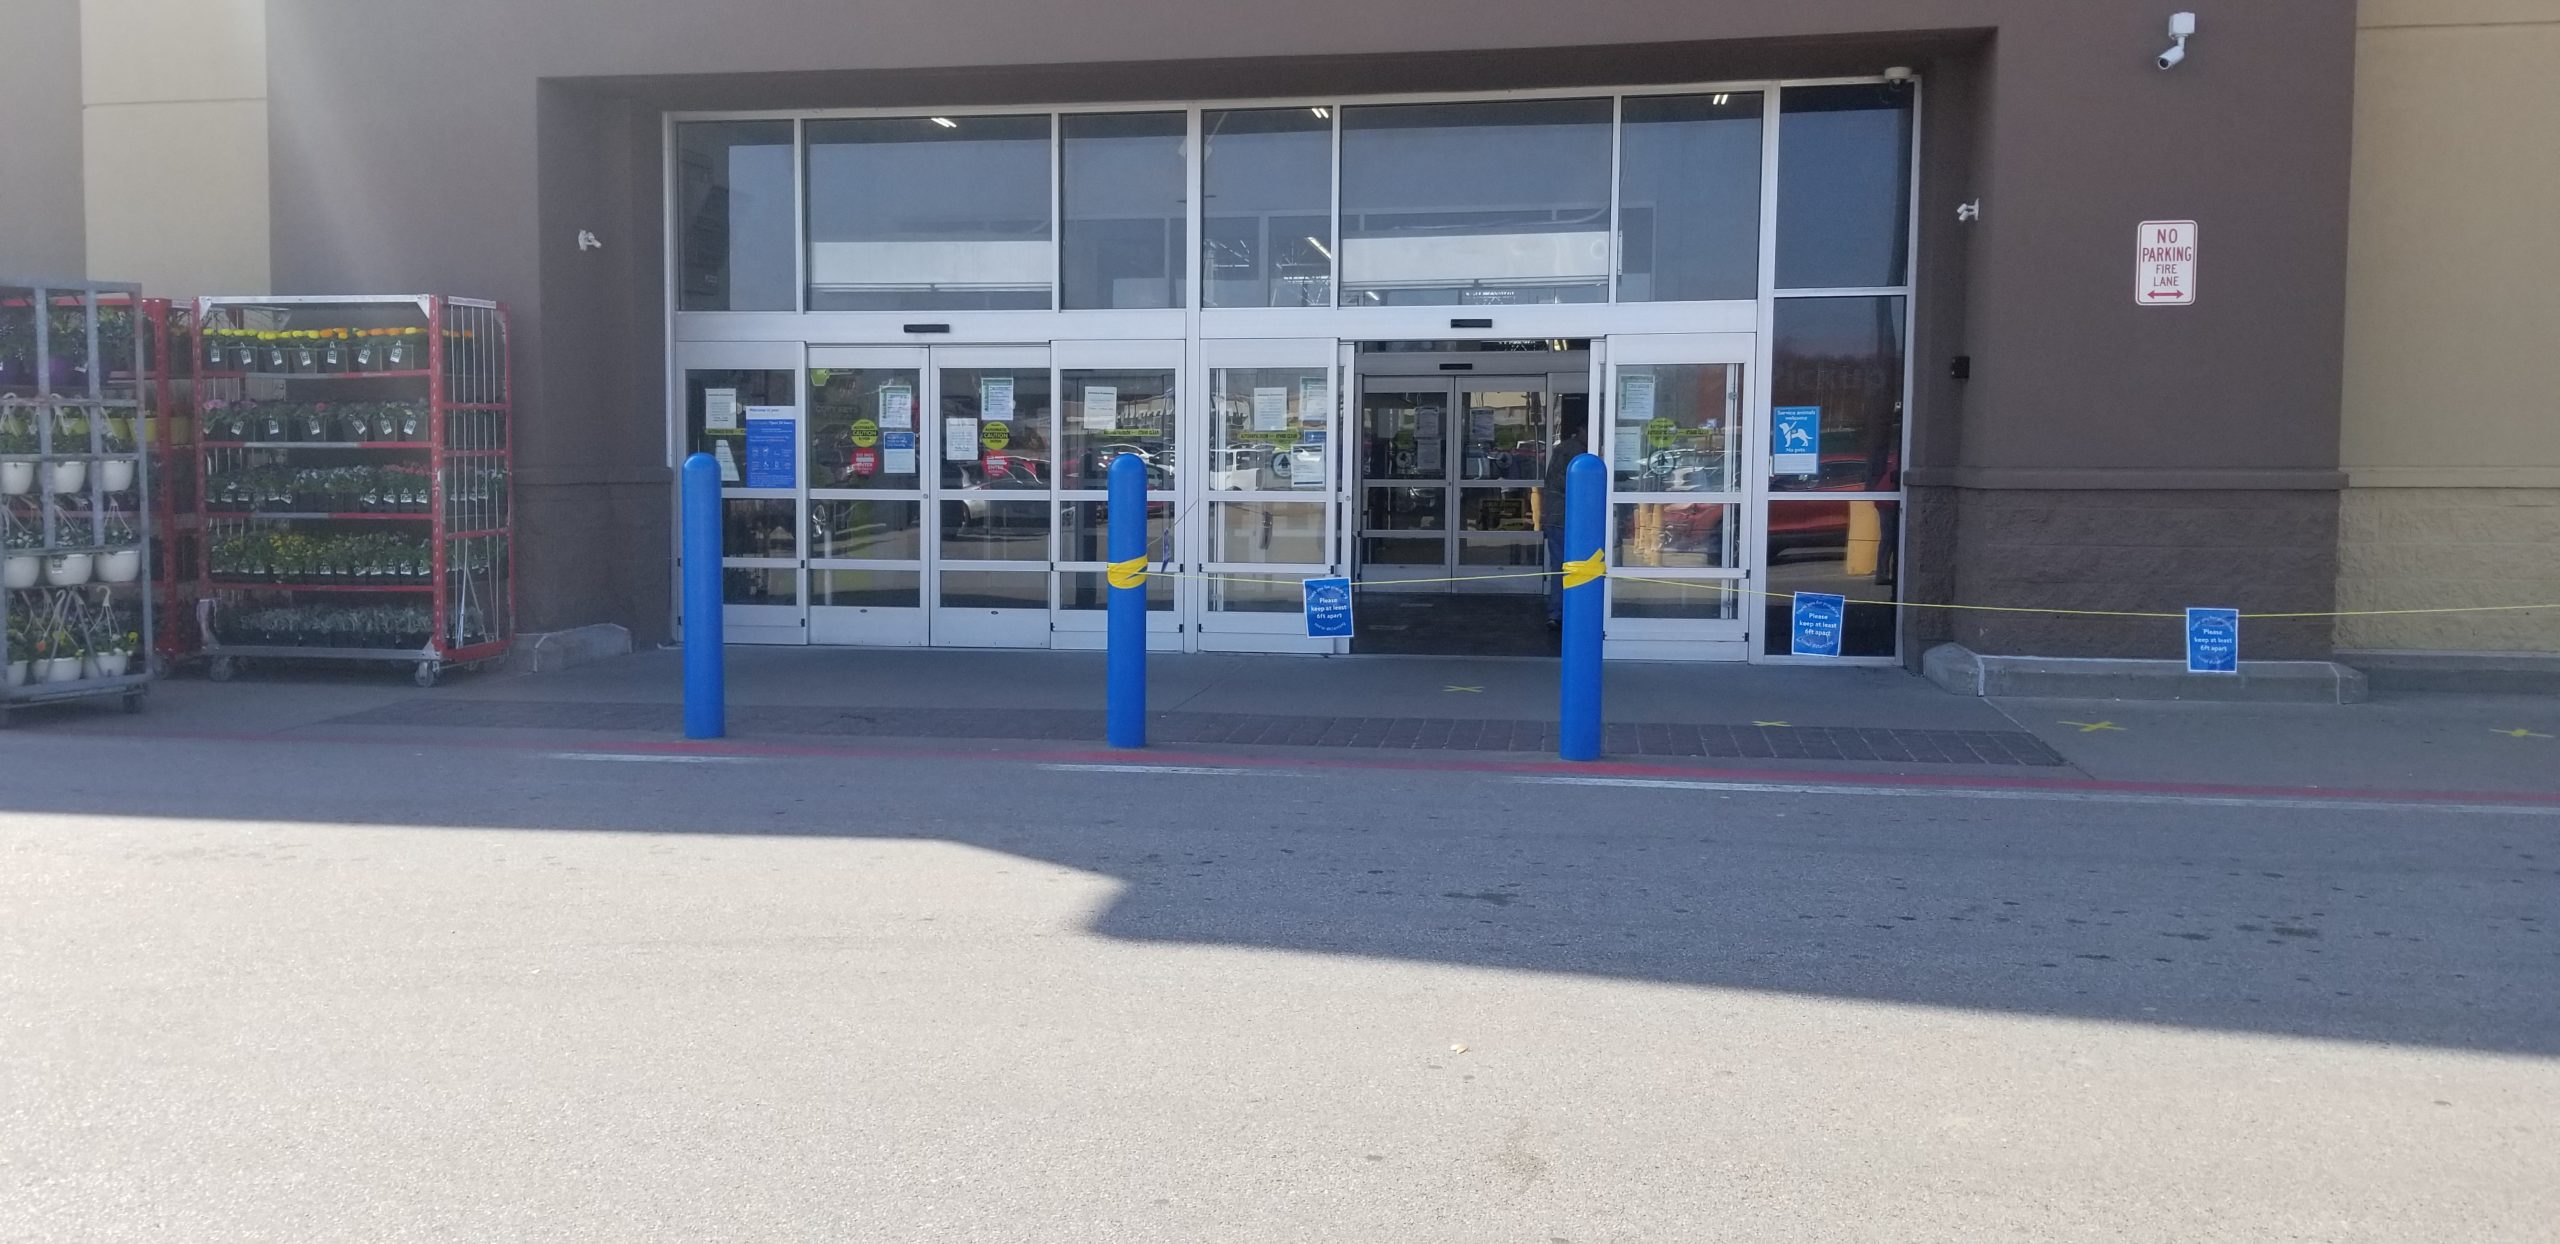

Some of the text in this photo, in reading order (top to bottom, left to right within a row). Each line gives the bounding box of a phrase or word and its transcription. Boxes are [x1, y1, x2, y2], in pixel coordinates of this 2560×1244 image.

[2157, 228, 2178, 244] NO
[2142, 246, 2192, 263] PARKING
[2155, 264, 2178, 275] FIRE
[2153, 276, 2180, 287] LANE
[1799, 620, 1814, 628] keep
